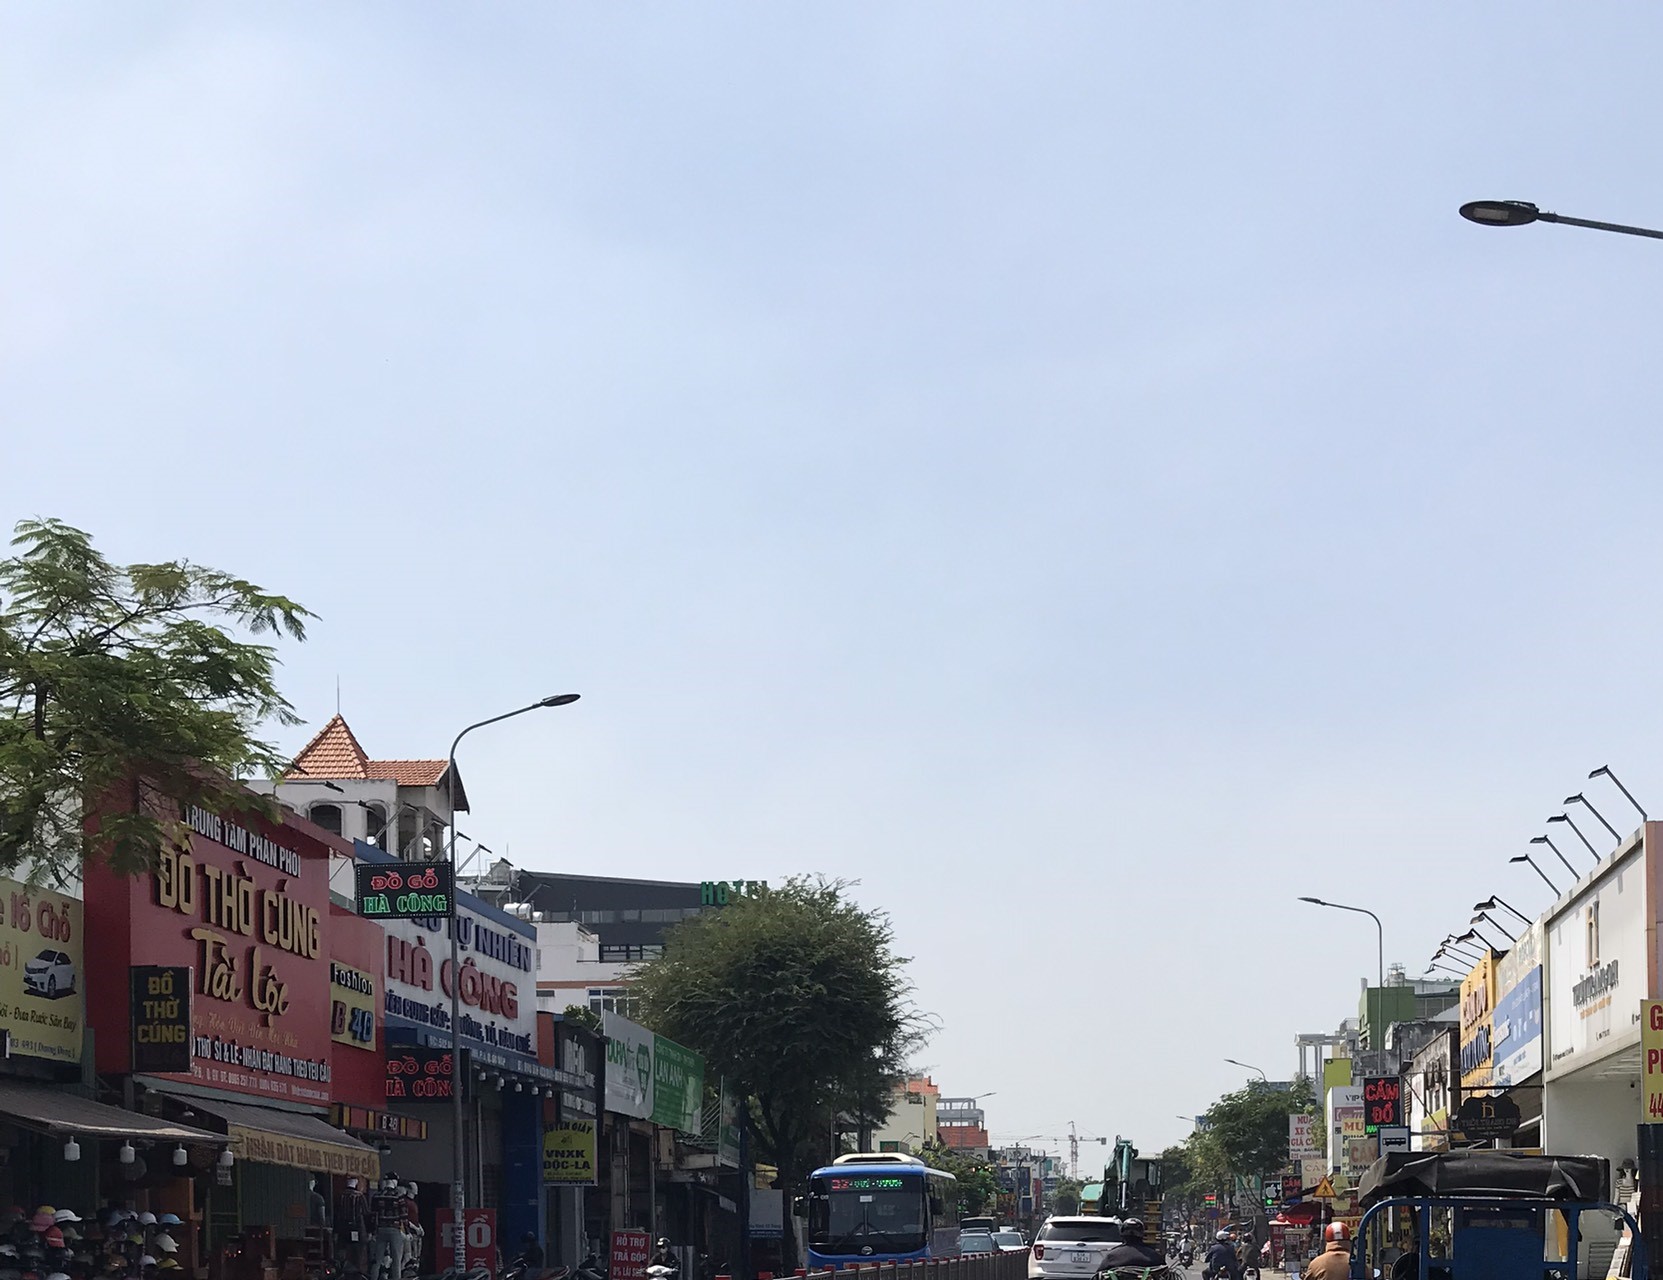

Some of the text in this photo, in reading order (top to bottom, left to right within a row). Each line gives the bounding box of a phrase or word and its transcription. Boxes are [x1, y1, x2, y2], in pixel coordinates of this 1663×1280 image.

[250, 834, 278, 867] PHÂN
[371, 867, 439, 890] ĐỒ GỖ
[204, 860, 256, 937] THỜ
[263, 879, 321, 960] CÚNG
[363, 892, 448, 914] HÀ CÔNG
[191, 928, 243, 1002] Tài
[475, 924, 532, 973] NHIÊN
[388, 935, 518, 1020] HÀ CÔNG
[387, 1055, 420, 1075] ĐỒ
[424, 1053, 453, 1075] GỖ
